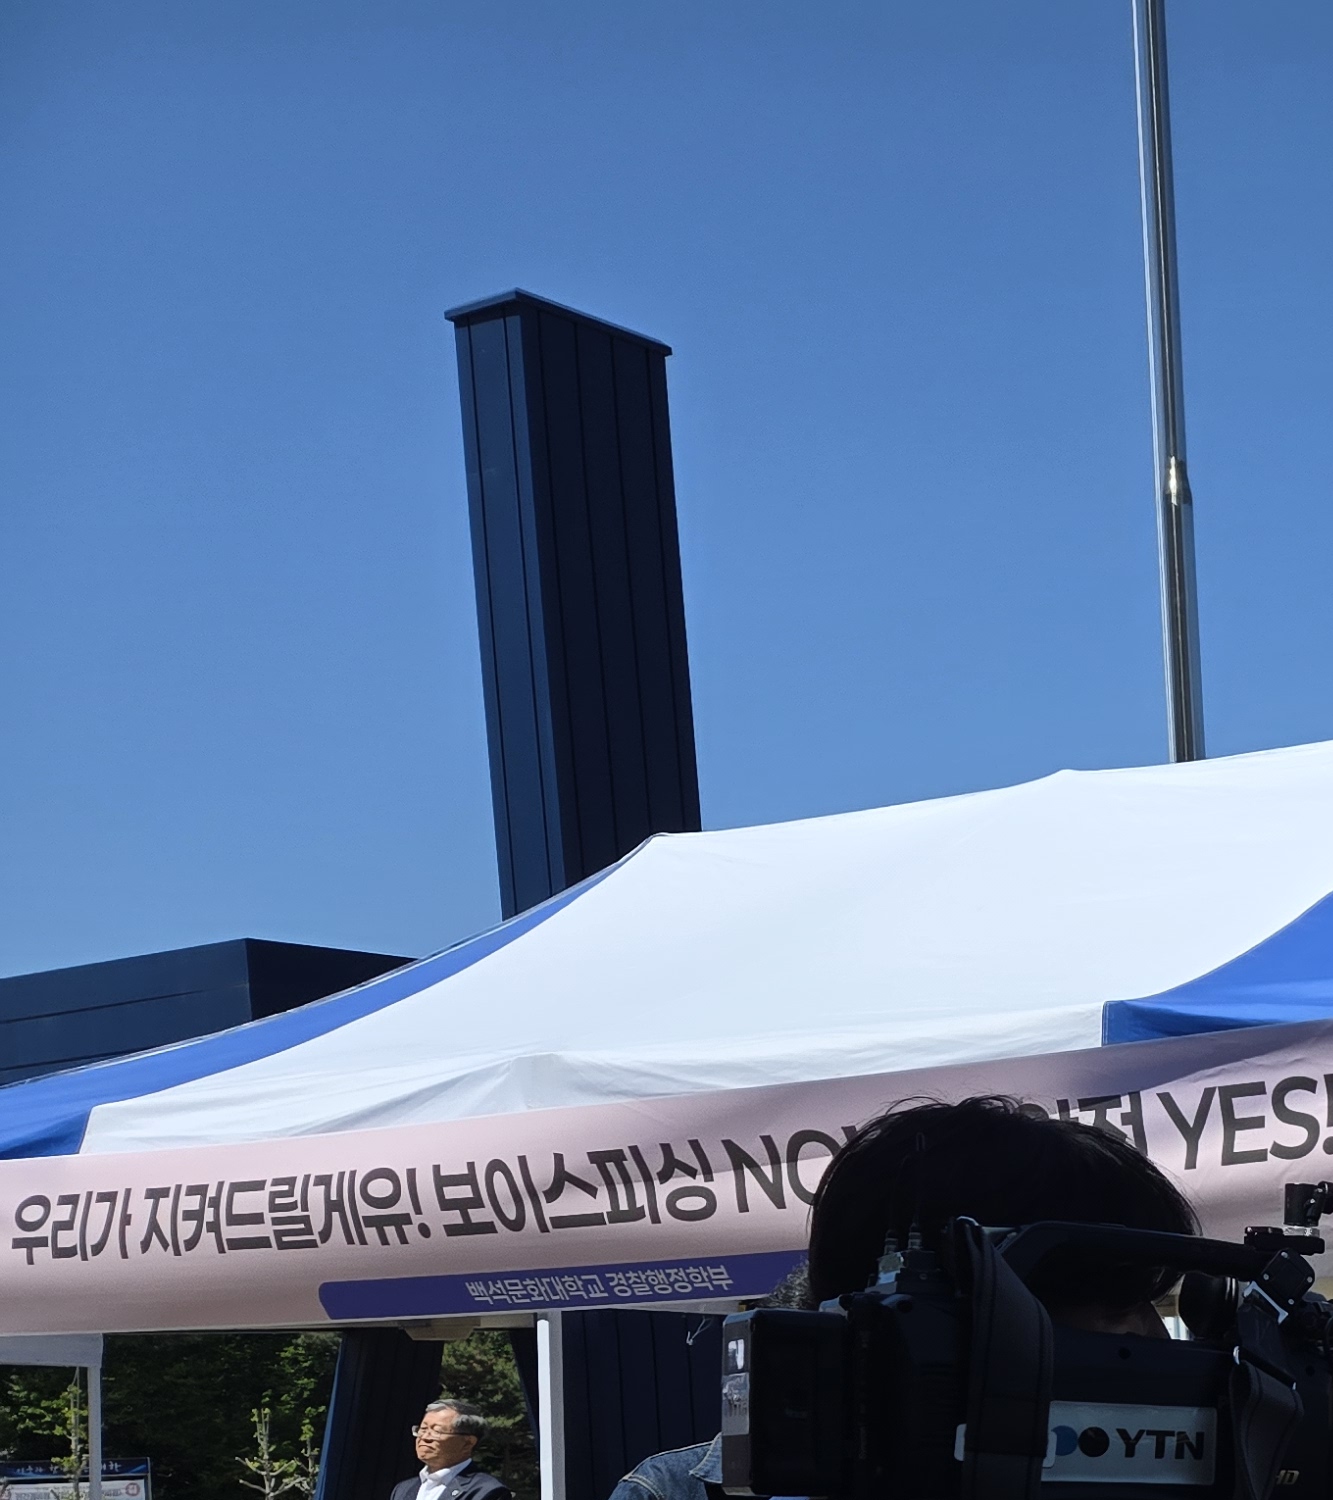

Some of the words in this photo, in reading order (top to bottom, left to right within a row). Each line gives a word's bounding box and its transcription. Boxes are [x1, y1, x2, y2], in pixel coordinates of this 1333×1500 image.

[12, 1185, 131, 1265] 우리가
[140, 1166, 430, 1258] 지켜드릴게유!
[432, 1137, 719, 1238] 보이스피싱
[721, 1125, 858, 1213] NO
[466, 1273, 605, 1306] 백석문화대학교
[609, 1261, 734, 1297] 경찰행정학부
[1116, 1427, 1204, 1460] YTN
